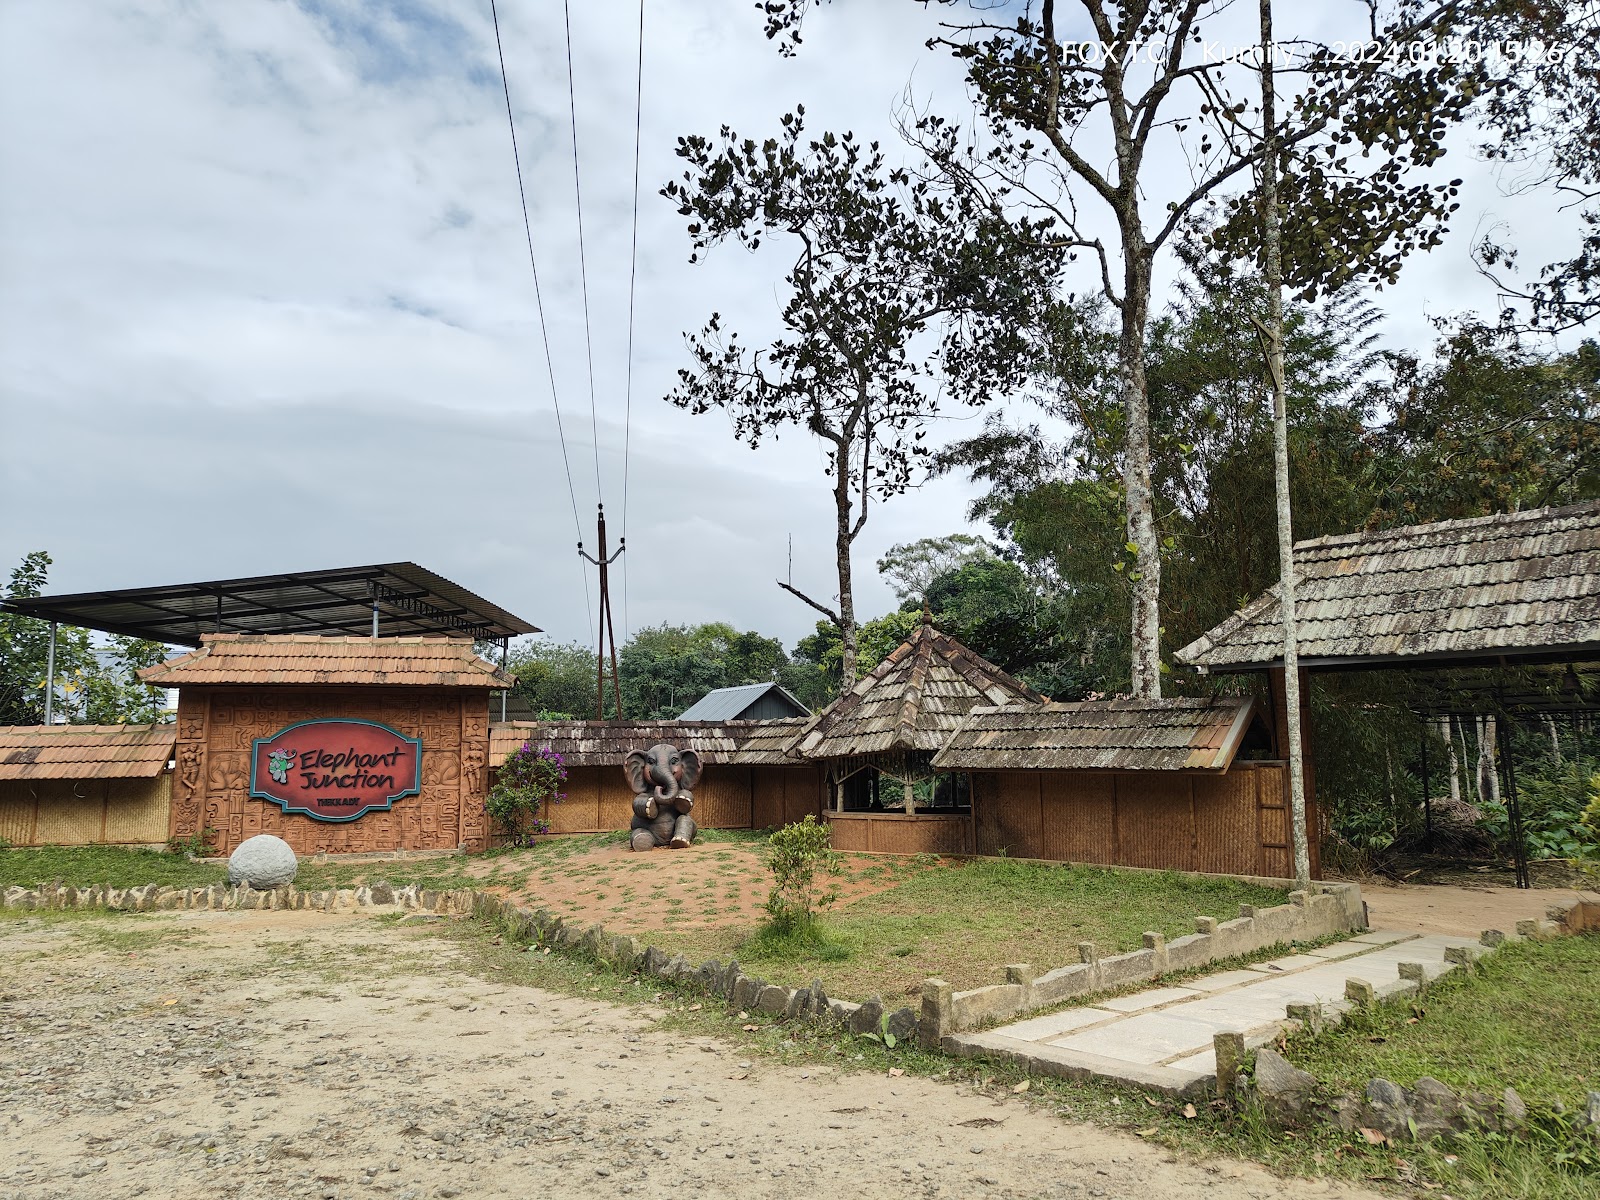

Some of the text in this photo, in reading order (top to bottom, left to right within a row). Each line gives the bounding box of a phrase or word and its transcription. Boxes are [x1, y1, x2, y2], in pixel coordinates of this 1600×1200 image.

[300, 746, 405, 773] Elephant
[300, 769, 394, 789] Junction
[316, 797, 361, 807] THEKKADY
